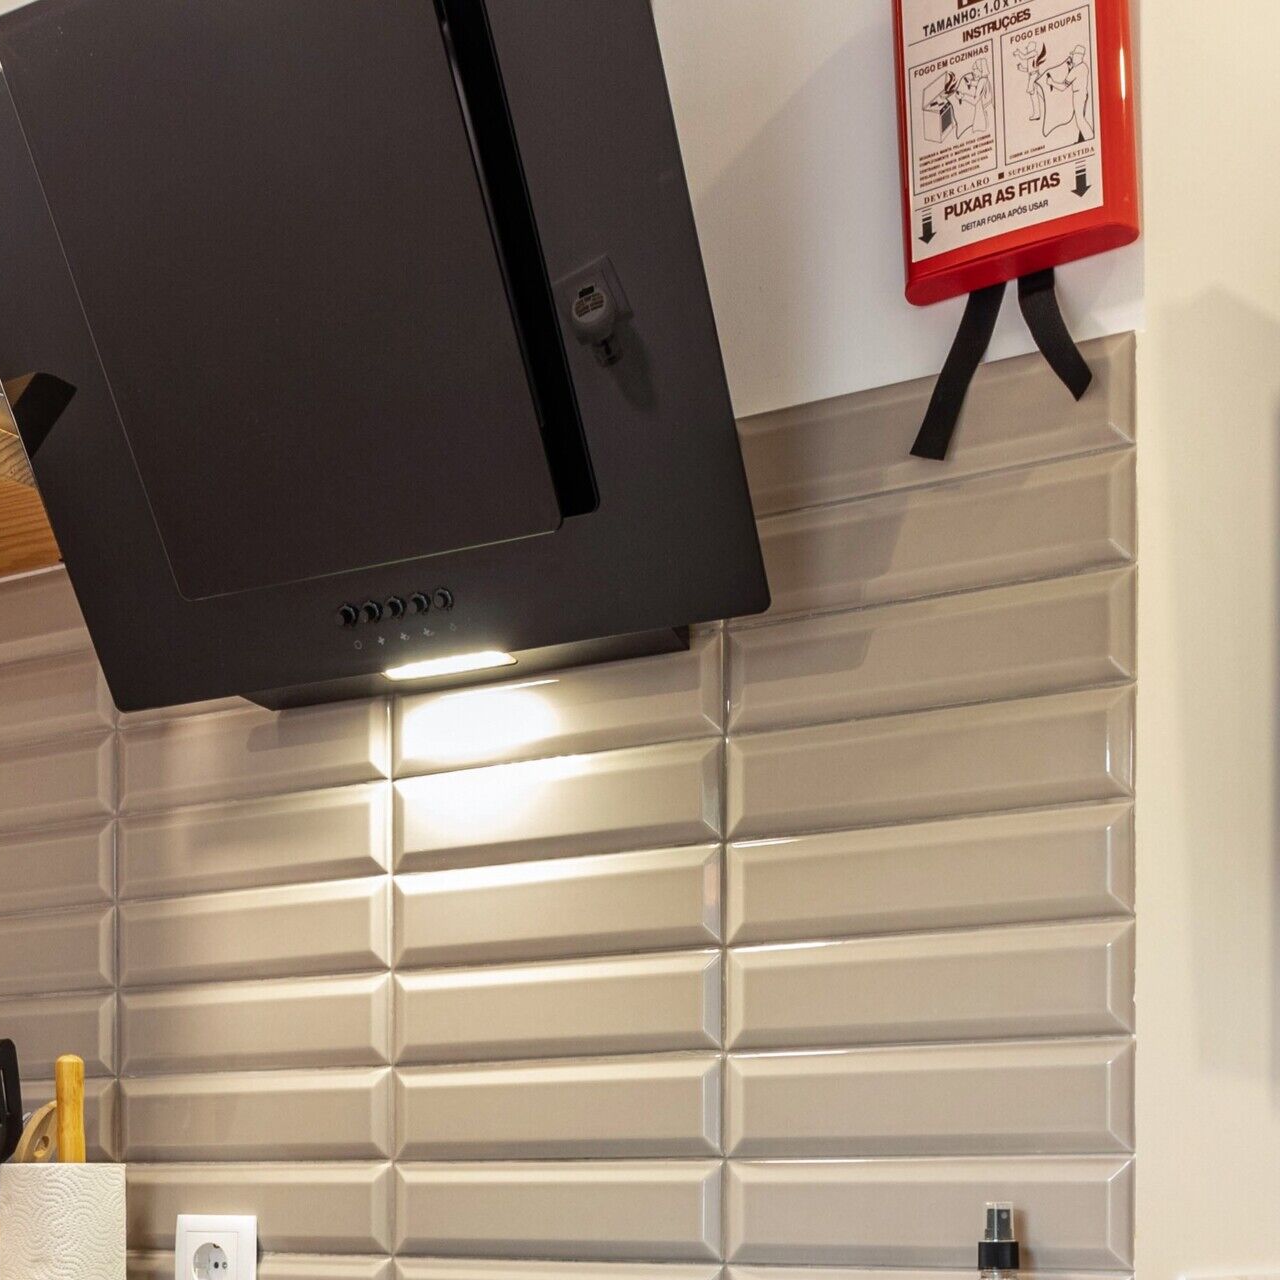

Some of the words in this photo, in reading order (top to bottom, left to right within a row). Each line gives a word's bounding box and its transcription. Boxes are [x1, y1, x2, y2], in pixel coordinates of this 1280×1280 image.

[923, 8, 980, 37] TAMANHO:
[1010, 30, 1033, 44] FOGO
[1034, 25, 1046, 36] EM
[1048, 13, 1082, 31] ROUPAS
[913, 64, 936, 78] FOGO
[937, 60, 948, 70] EM
[949, 45, 989, 65] COZINHAS
[924, 189, 955, 205] DEVER
[957, 177, 990, 193] CLARO
[1052, 146, 1095, 166] REVESTIDA
[944, 193, 993, 220] PUXAR
[995, 186, 1015, 205] AS
[1019, 172, 1061, 197] FITAS
[961, 219, 986, 232] DEITAR
[987, 213, 1006, 223] FORA
[1007, 204, 1027, 219] APÓS
[1028, 199, 1049, 213] USAR
